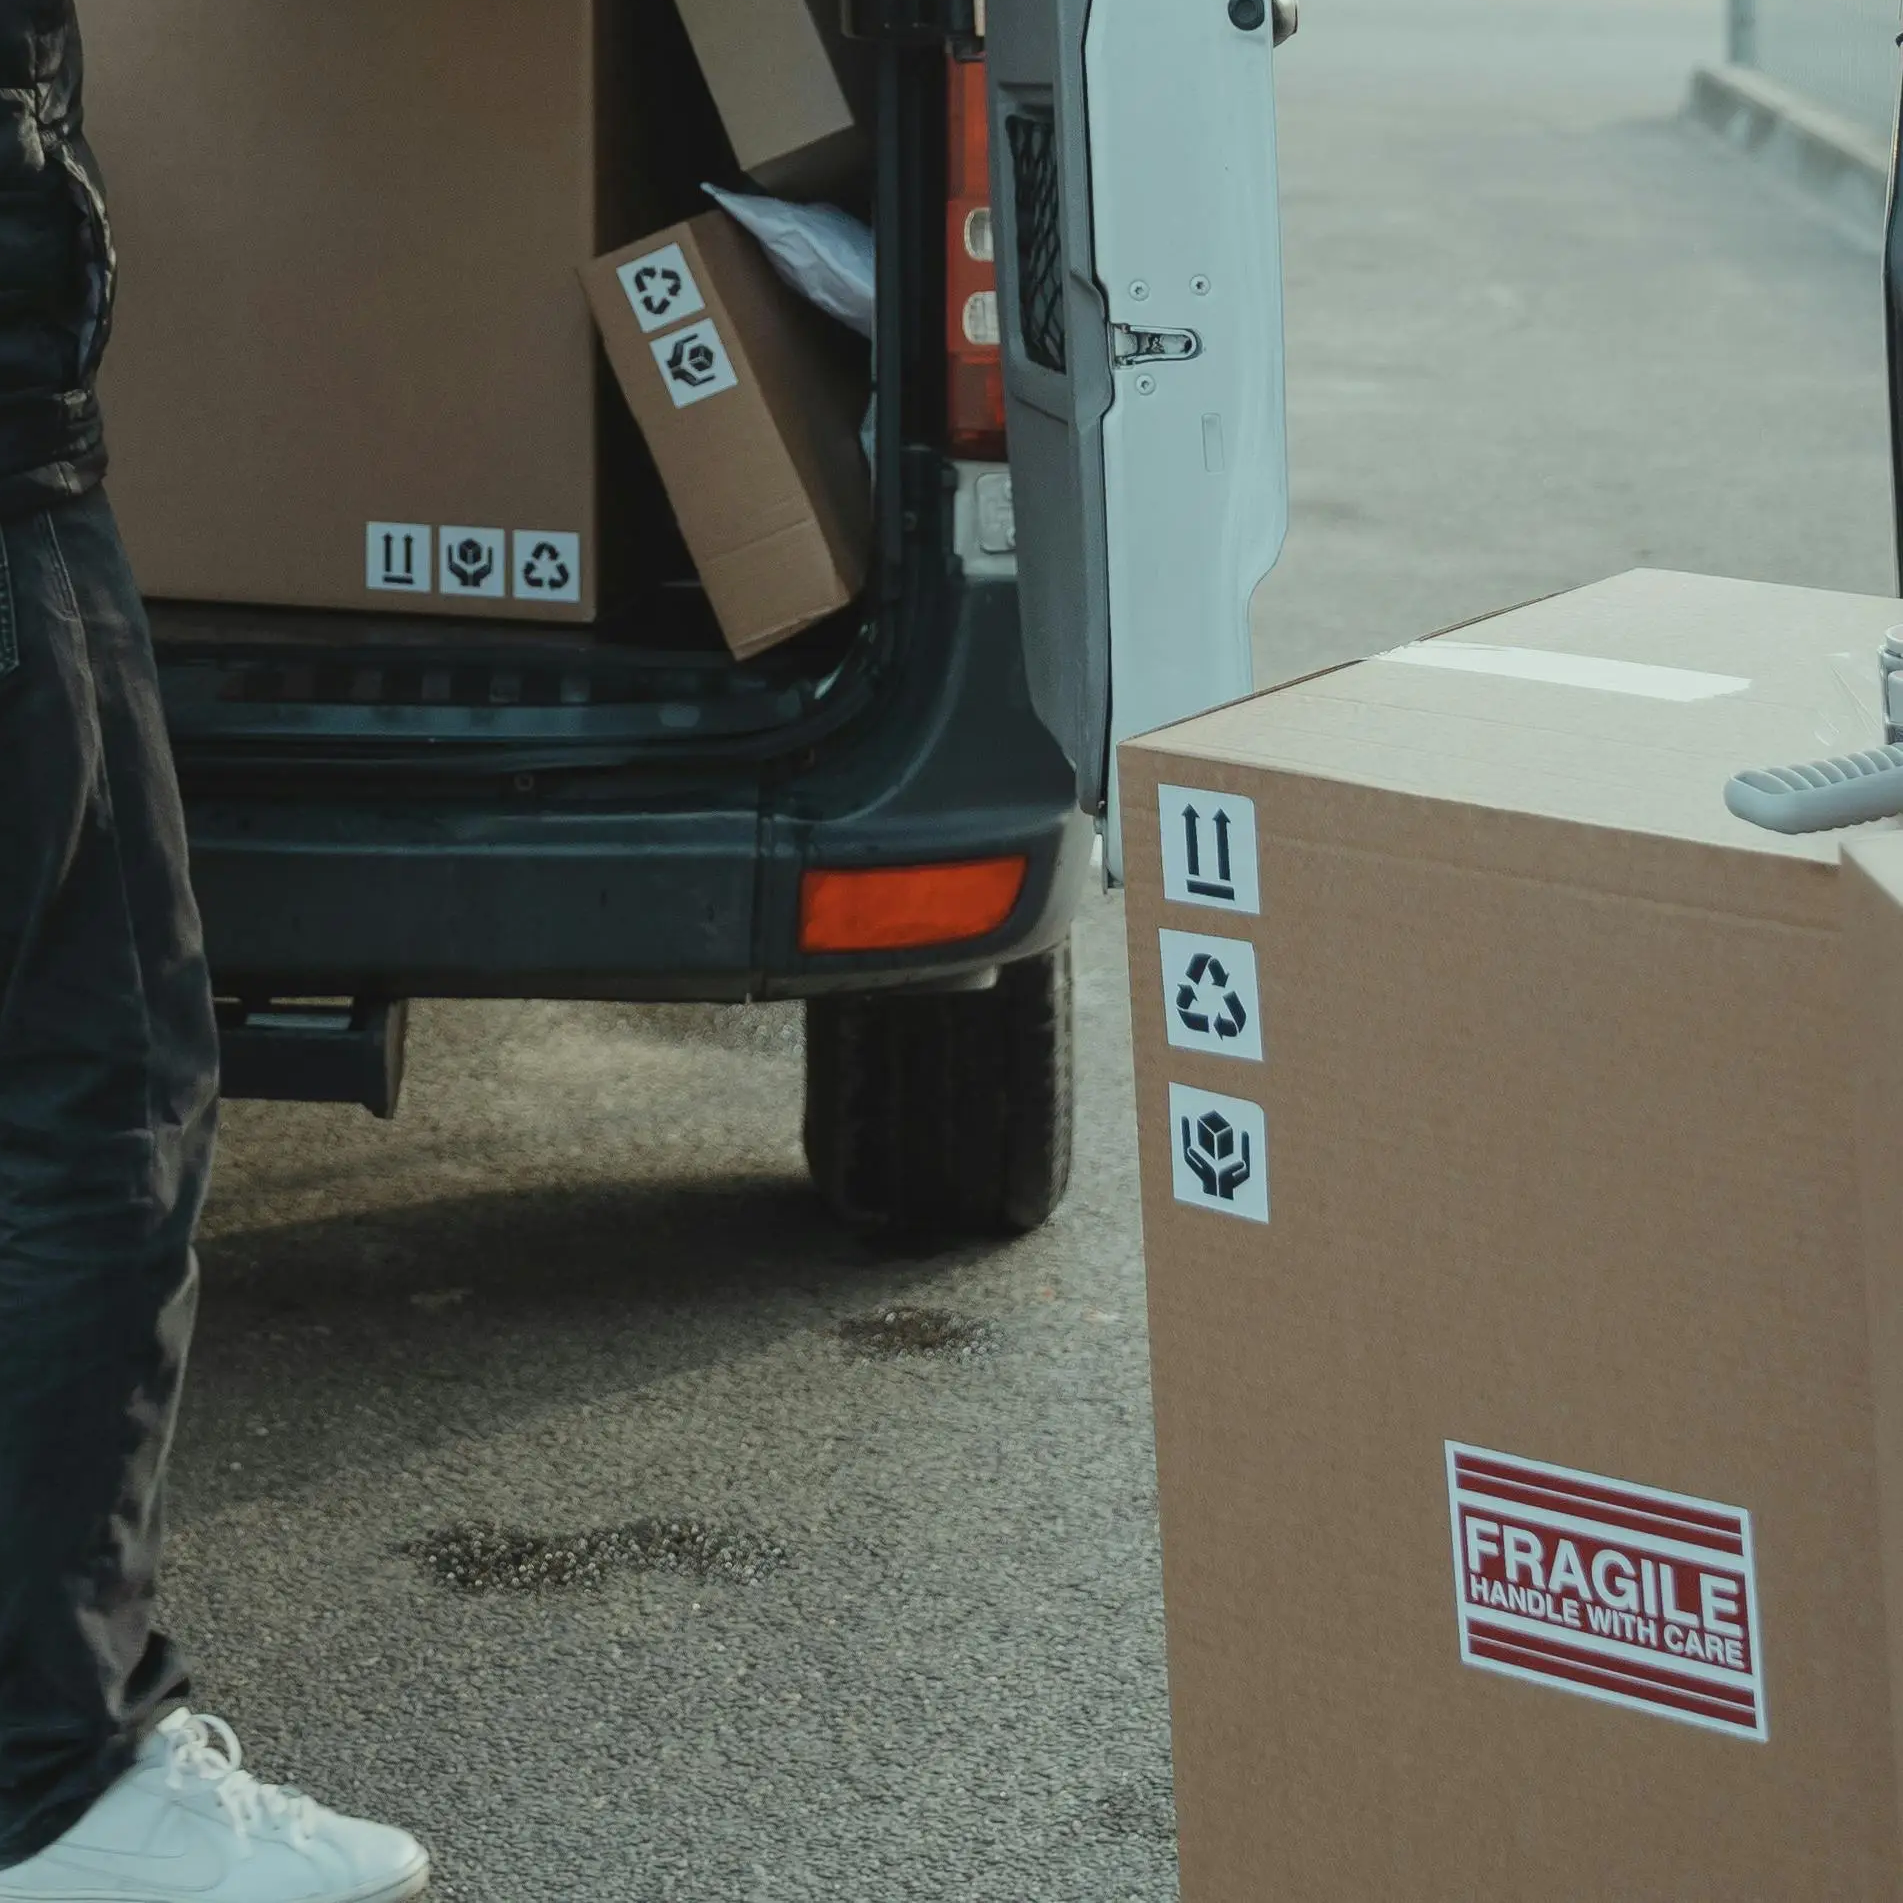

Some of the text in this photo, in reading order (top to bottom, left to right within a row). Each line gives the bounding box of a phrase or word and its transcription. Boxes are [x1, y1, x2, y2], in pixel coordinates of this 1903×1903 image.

[1465, 1515, 1744, 1638] FRAGILE
[1469, 1574, 1746, 1669] HANDLE WITH CARE
